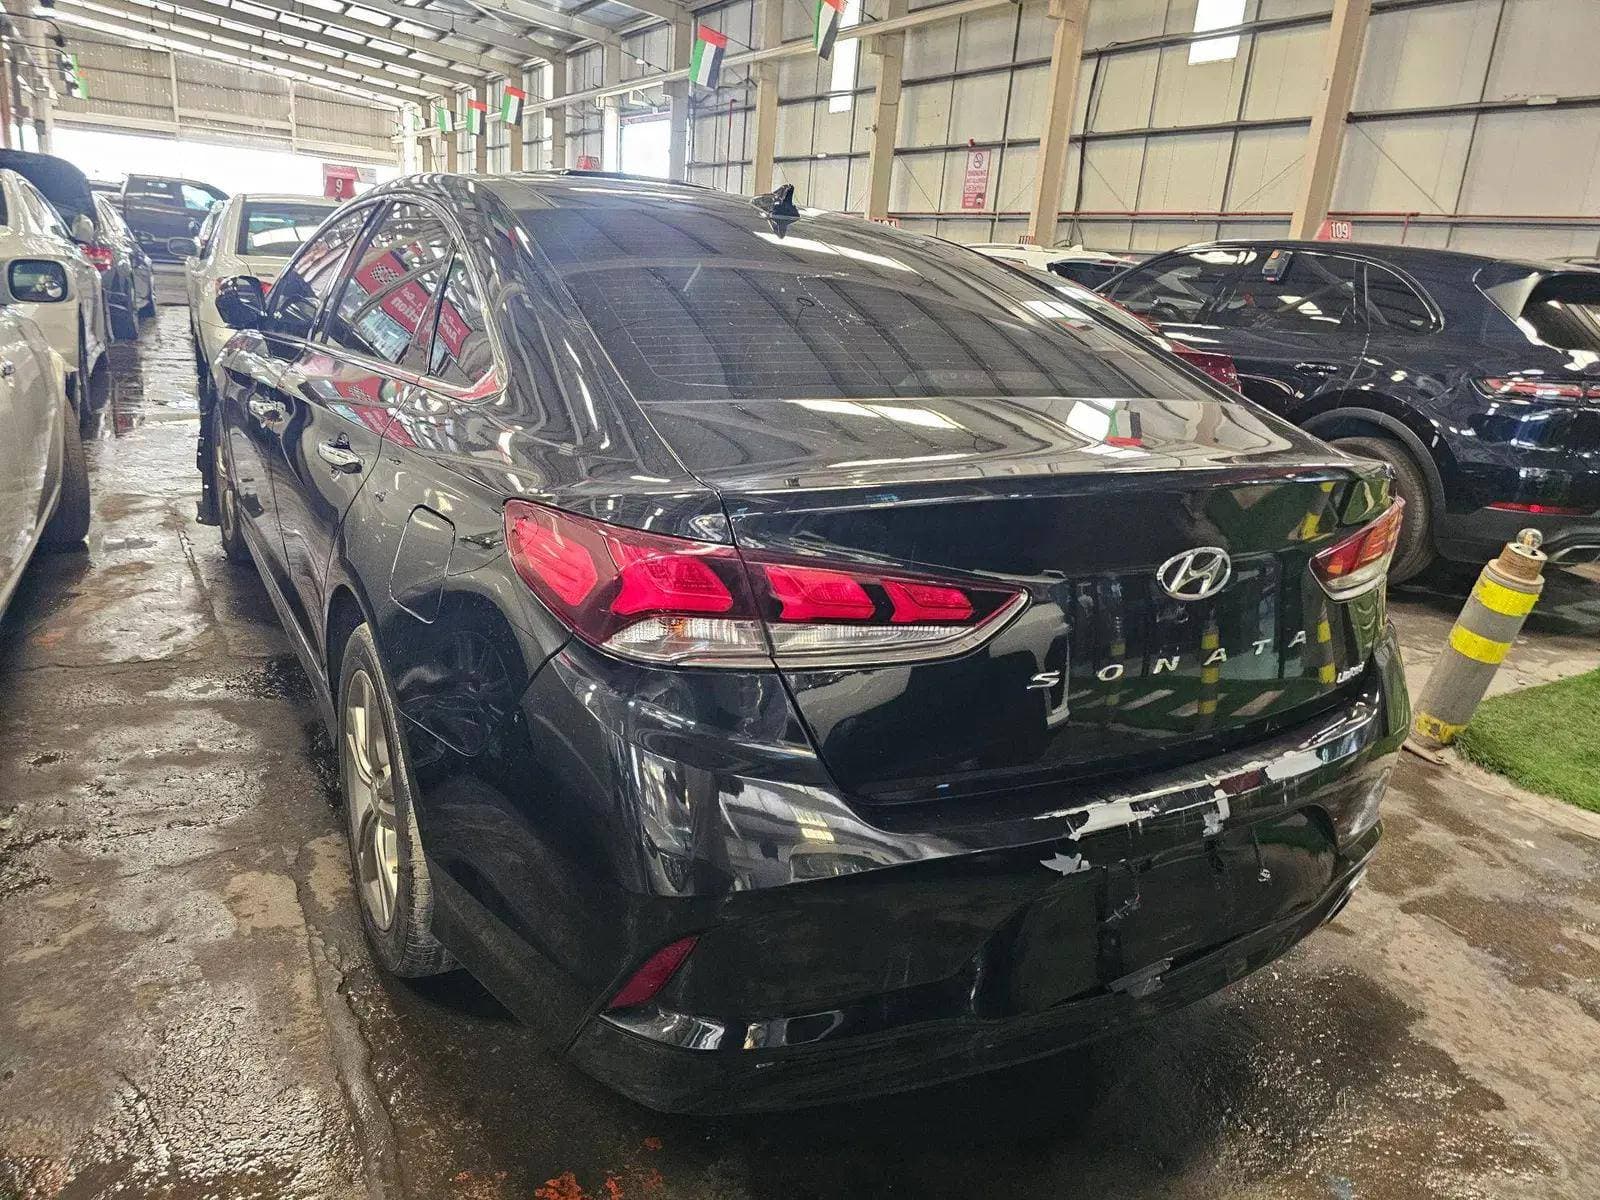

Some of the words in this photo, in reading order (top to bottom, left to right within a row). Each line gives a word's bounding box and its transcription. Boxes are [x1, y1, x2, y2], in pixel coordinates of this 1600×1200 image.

[335, 178, 343, 193] 9
[1330, 221, 1349, 239] 109
[1026, 630, 1307, 690] SONATA
